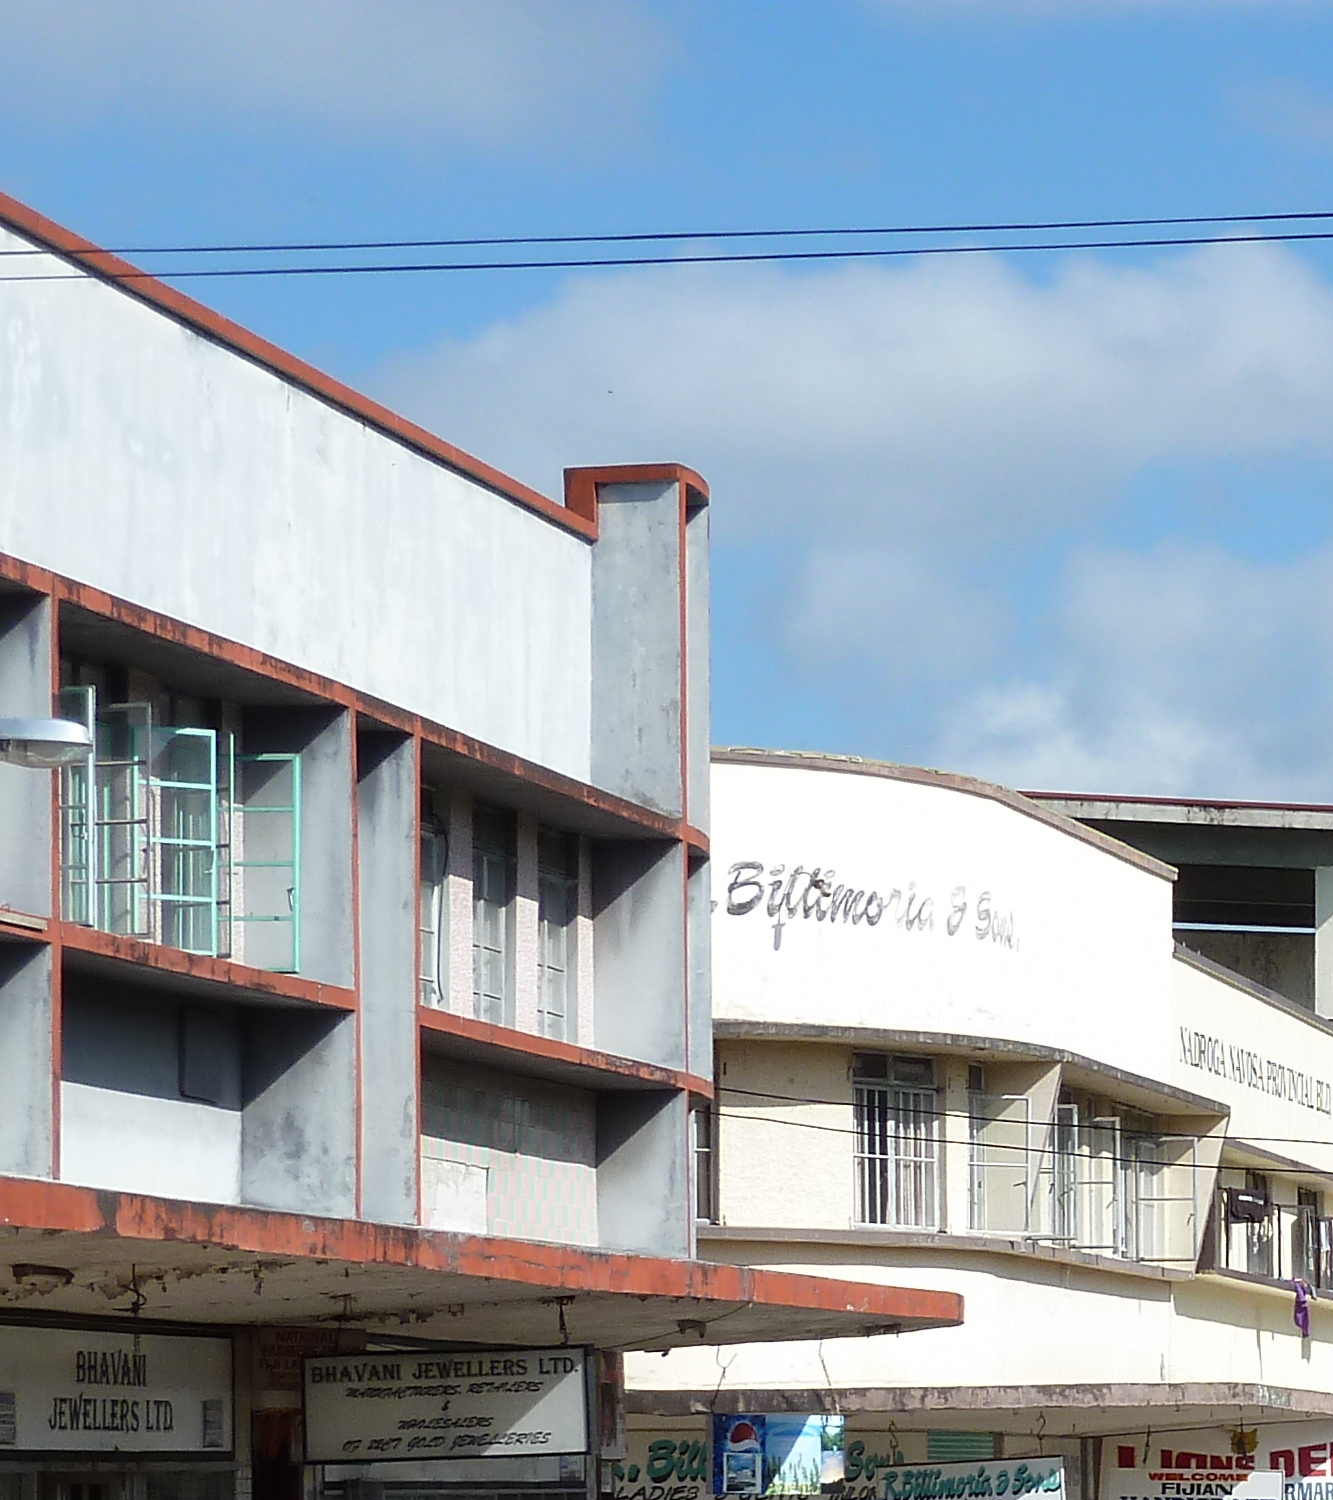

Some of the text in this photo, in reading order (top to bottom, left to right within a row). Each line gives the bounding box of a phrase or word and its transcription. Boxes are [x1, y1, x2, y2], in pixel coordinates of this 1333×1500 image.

[1179, 1026, 1227, 1078] NADROGA
[1229, 1044, 1265, 1092] NAVOSA
[76, 1349, 148, 1387] BHAVANI
[311, 1362, 401, 1384] BHAVANI
[412, 1357, 528, 1380] JEWELLERS
[467, 1380, 543, 1395] RETAILERS
[49, 1392, 139, 1432] JEWELLERS
[145, 1400, 173, 1431] LTD
[397, 1416, 494, 1431] WHOLESALERS
[408, 1434, 445, 1451] GOLD
[1012, 1463, 1061, 1495] Sons
[1148, 1472, 1250, 1482] WELCOME
[616, 1485, 698, 1500] LADIES
[1161, 1482, 1233, 1496] FIJIAN
